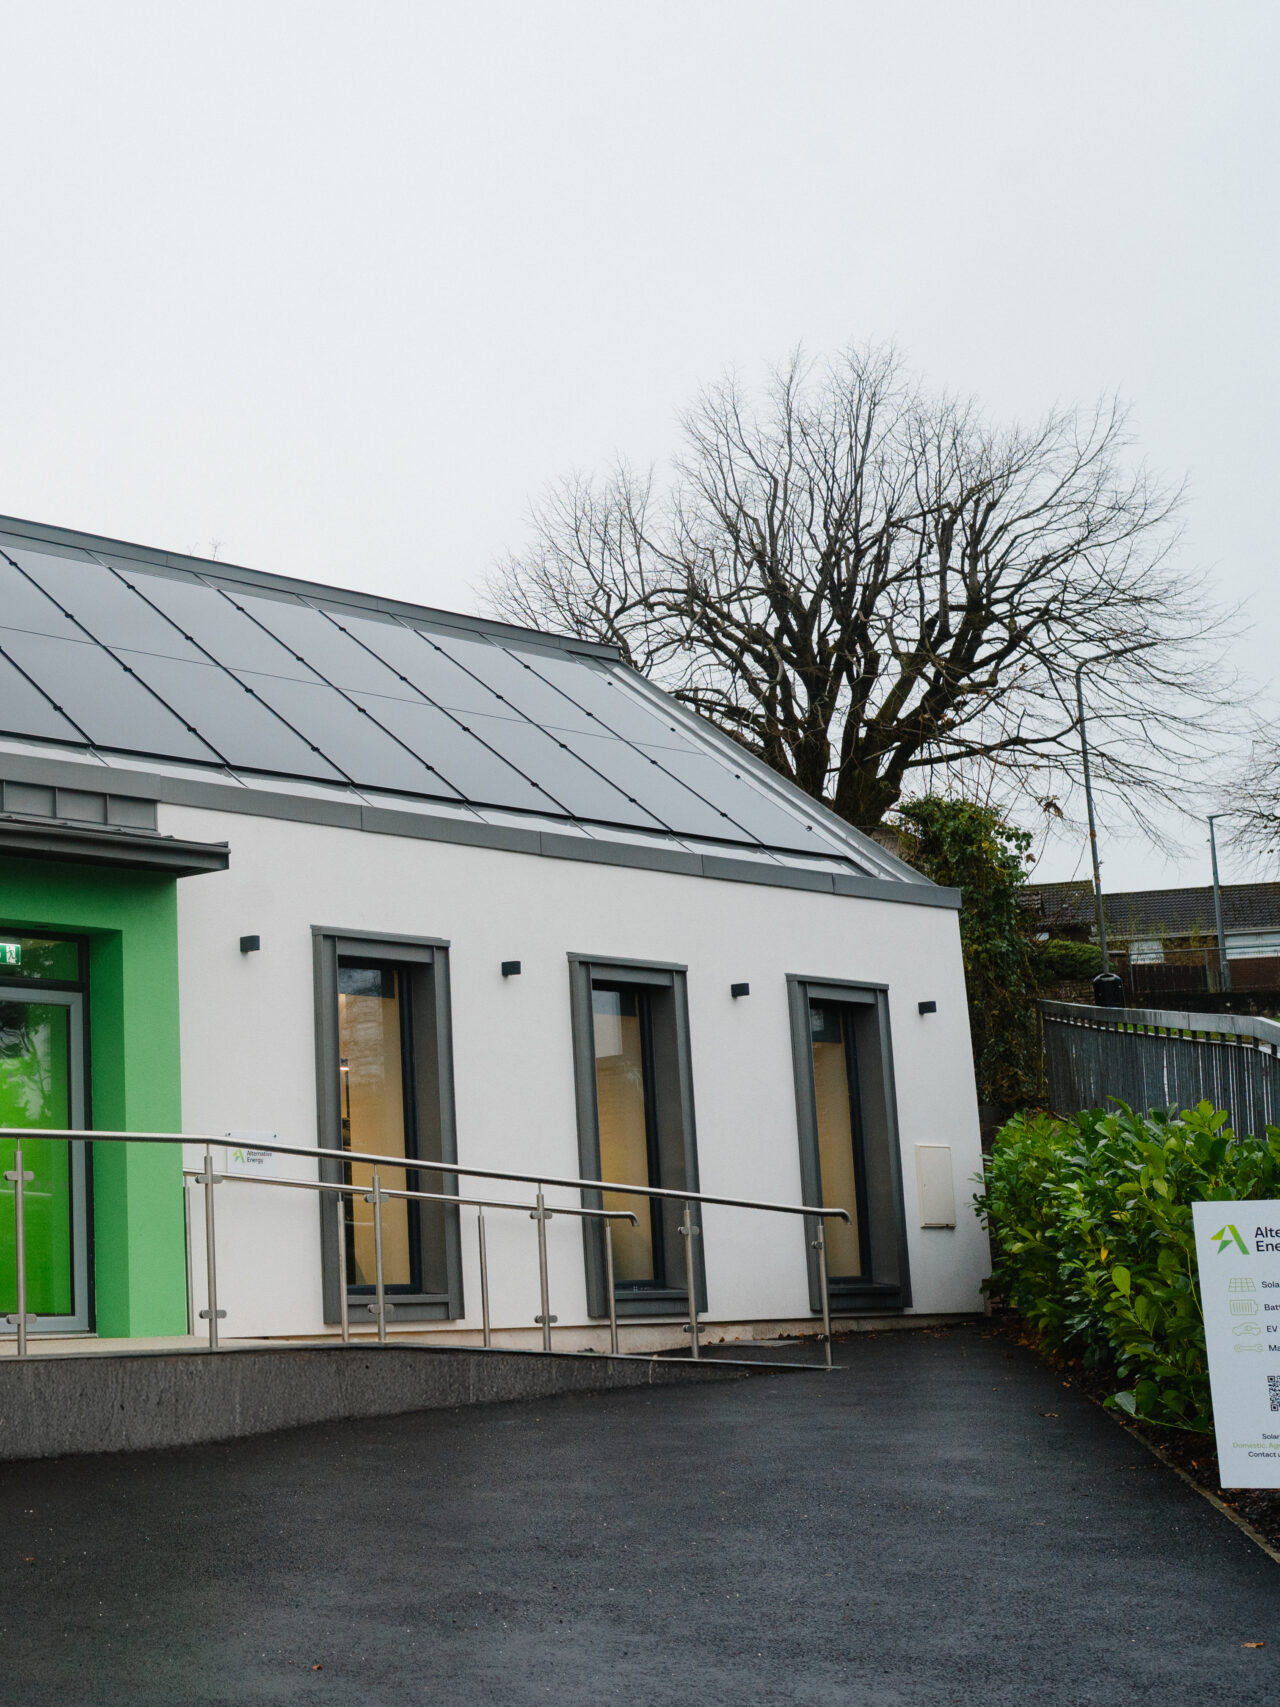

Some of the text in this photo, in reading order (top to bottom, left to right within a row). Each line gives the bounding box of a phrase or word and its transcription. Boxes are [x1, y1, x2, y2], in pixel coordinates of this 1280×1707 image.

[1254, 1226, 1280, 1239] Alte
[1255, 1240, 1280, 1252] Ene
[1261, 1281, 1280, 1289] Sola
[1266, 1325, 1278, 1333] EV
